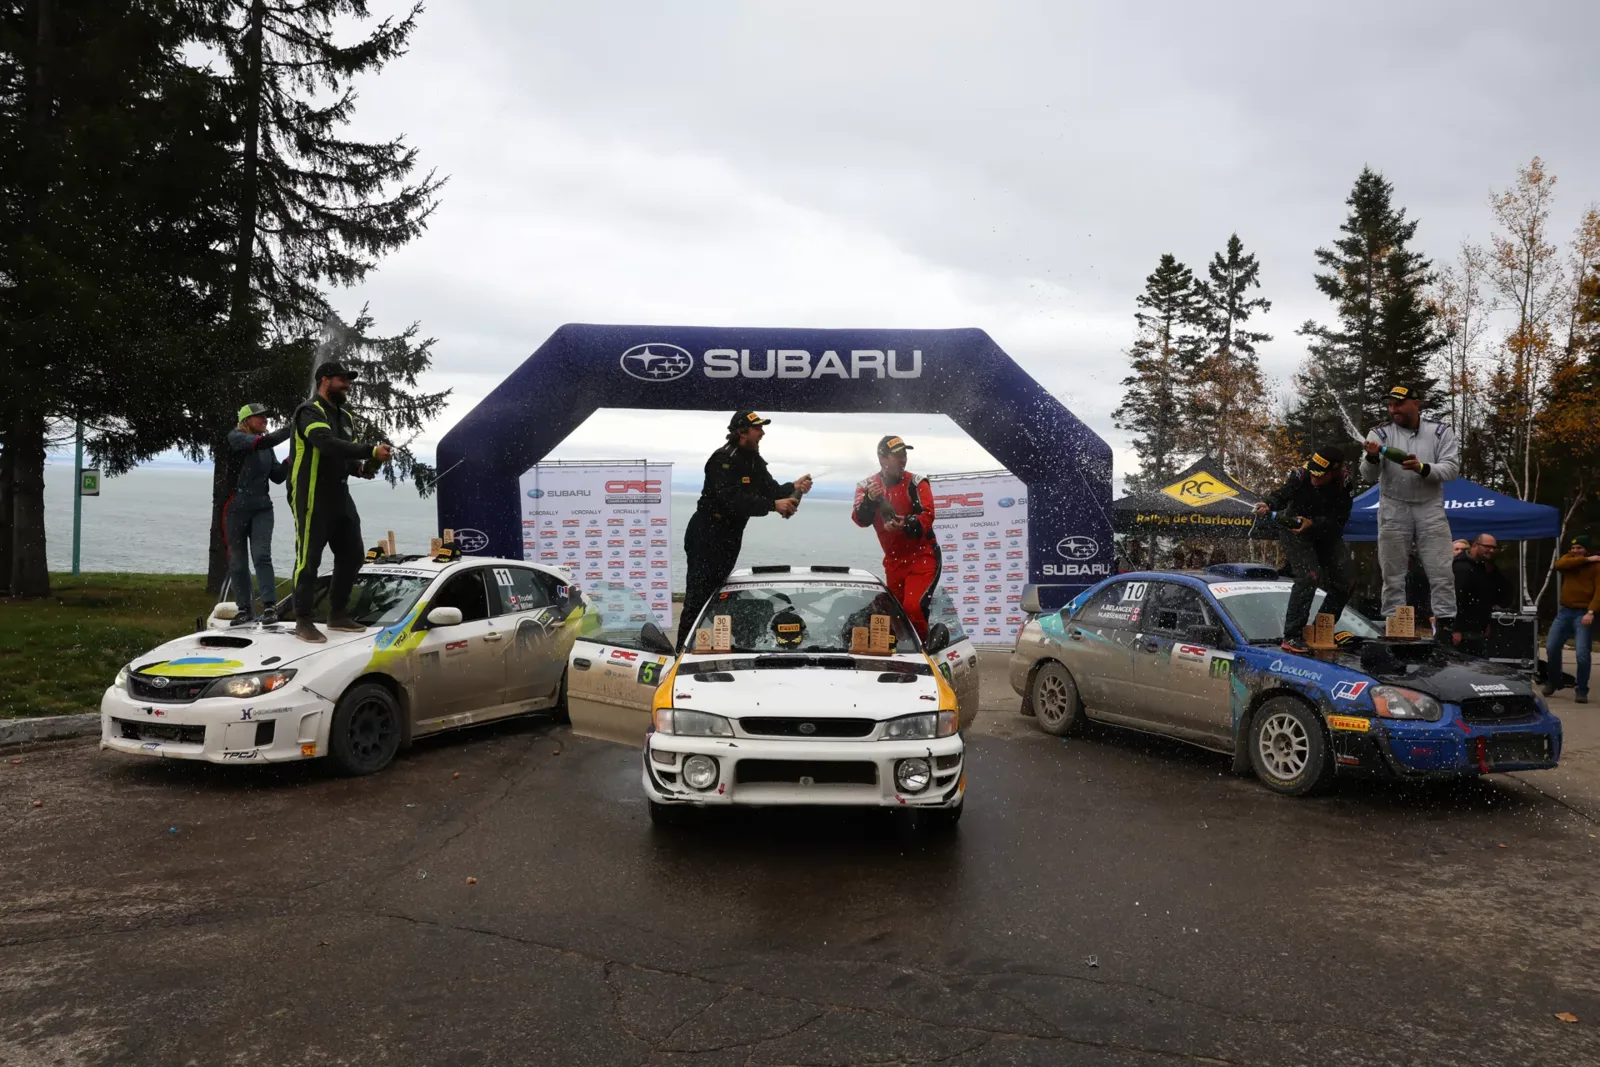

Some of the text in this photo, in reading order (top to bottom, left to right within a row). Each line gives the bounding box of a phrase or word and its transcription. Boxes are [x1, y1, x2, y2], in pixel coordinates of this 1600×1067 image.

[703, 349, 923, 379] SUBARU
[1180, 480, 1214, 498] RC
[1444, 498, 1496, 509] lbaie
[1173, 514, 1188, 523] de
[1190, 514, 1253, 526] Charlevoix
[495, 569, 510, 585] 11
[1042, 564, 1111, 576] SUBARU
[725, 582, 781, 590] CARSRally
[825, 582, 880, 591] SUBARU
[1127, 584, 1145, 600] 10
[1213, 586, 1229, 594] 10
[642, 663, 657, 683] 5
[1213, 658, 1230, 679] 10
